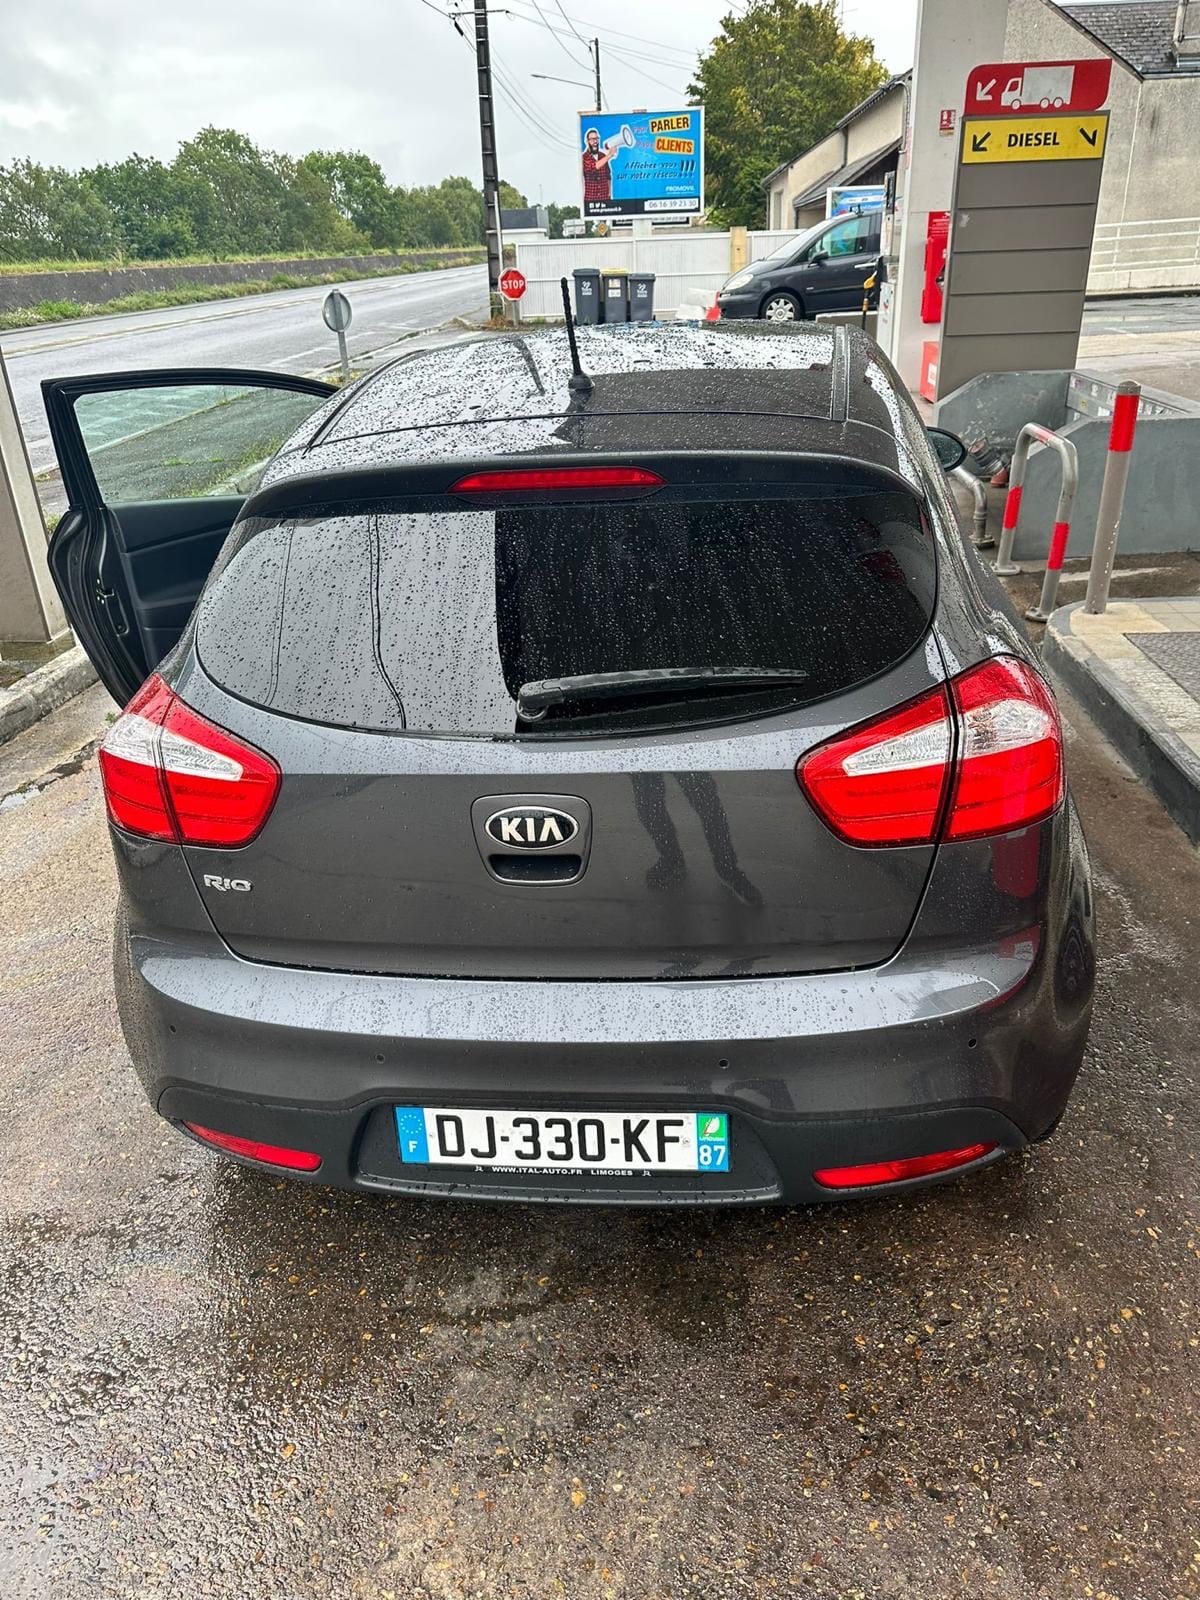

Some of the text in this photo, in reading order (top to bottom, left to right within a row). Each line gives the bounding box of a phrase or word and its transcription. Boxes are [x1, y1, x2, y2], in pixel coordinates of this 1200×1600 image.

[650, 116, 689, 132] PARLER
[656, 138, 693, 152] CLIENTS
[1007, 131, 1060, 148] DIESEL
[648, 201, 658, 209] 06
[502, 279, 525, 290] STOP
[499, 817, 564, 842] KIA
[203, 874, 252, 892] RIO
[435, 1114, 684, 1163] DJ-330-KF
[408, 1141, 417, 1154] F
[699, 1144, 726, 1166] 87
[491, 1165, 583, 1176] WWW.ITAL-AUTO.FR
[590, 1168, 634, 1177] LIMOGES
